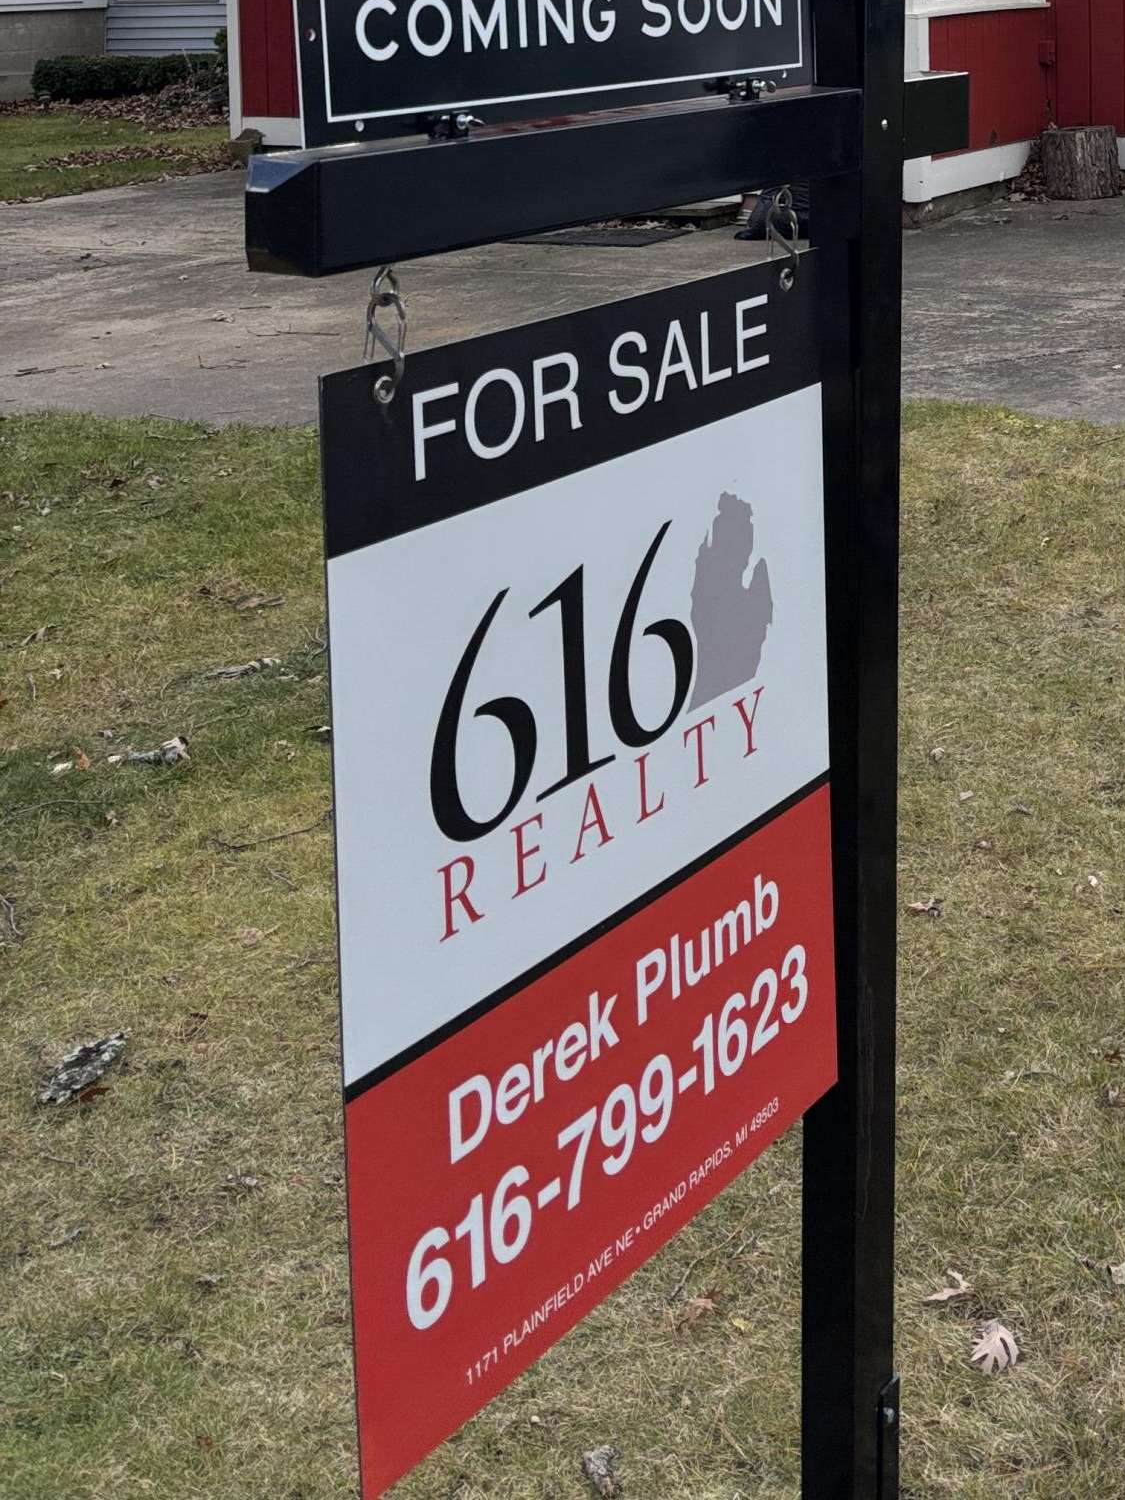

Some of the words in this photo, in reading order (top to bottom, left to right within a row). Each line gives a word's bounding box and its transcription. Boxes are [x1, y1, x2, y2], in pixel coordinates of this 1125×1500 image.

[412, 351, 582, 482] FOR
[608, 293, 770, 415] SALE
[429, 519, 694, 843] 616
[437, 687, 765, 943] REALTY
[406, 944, 808, 1330] 616-799-1623
[448, 990, 619, 1164] Derek
[636, 874, 779, 1026] Plumb
[465, 1347, 498, 1385] 1171
[503, 1273, 584, 1355] PLAINFIELD
[587, 1247, 614, 1283] AVE
[615, 1228, 634, 1258] NE
[643, 1181, 687, 1231] GRAND
[689, 1141, 733, 1190] RAPIDS,
[735, 1123, 748, 1147] MI
[750, 1096, 779, 1133] 49503
